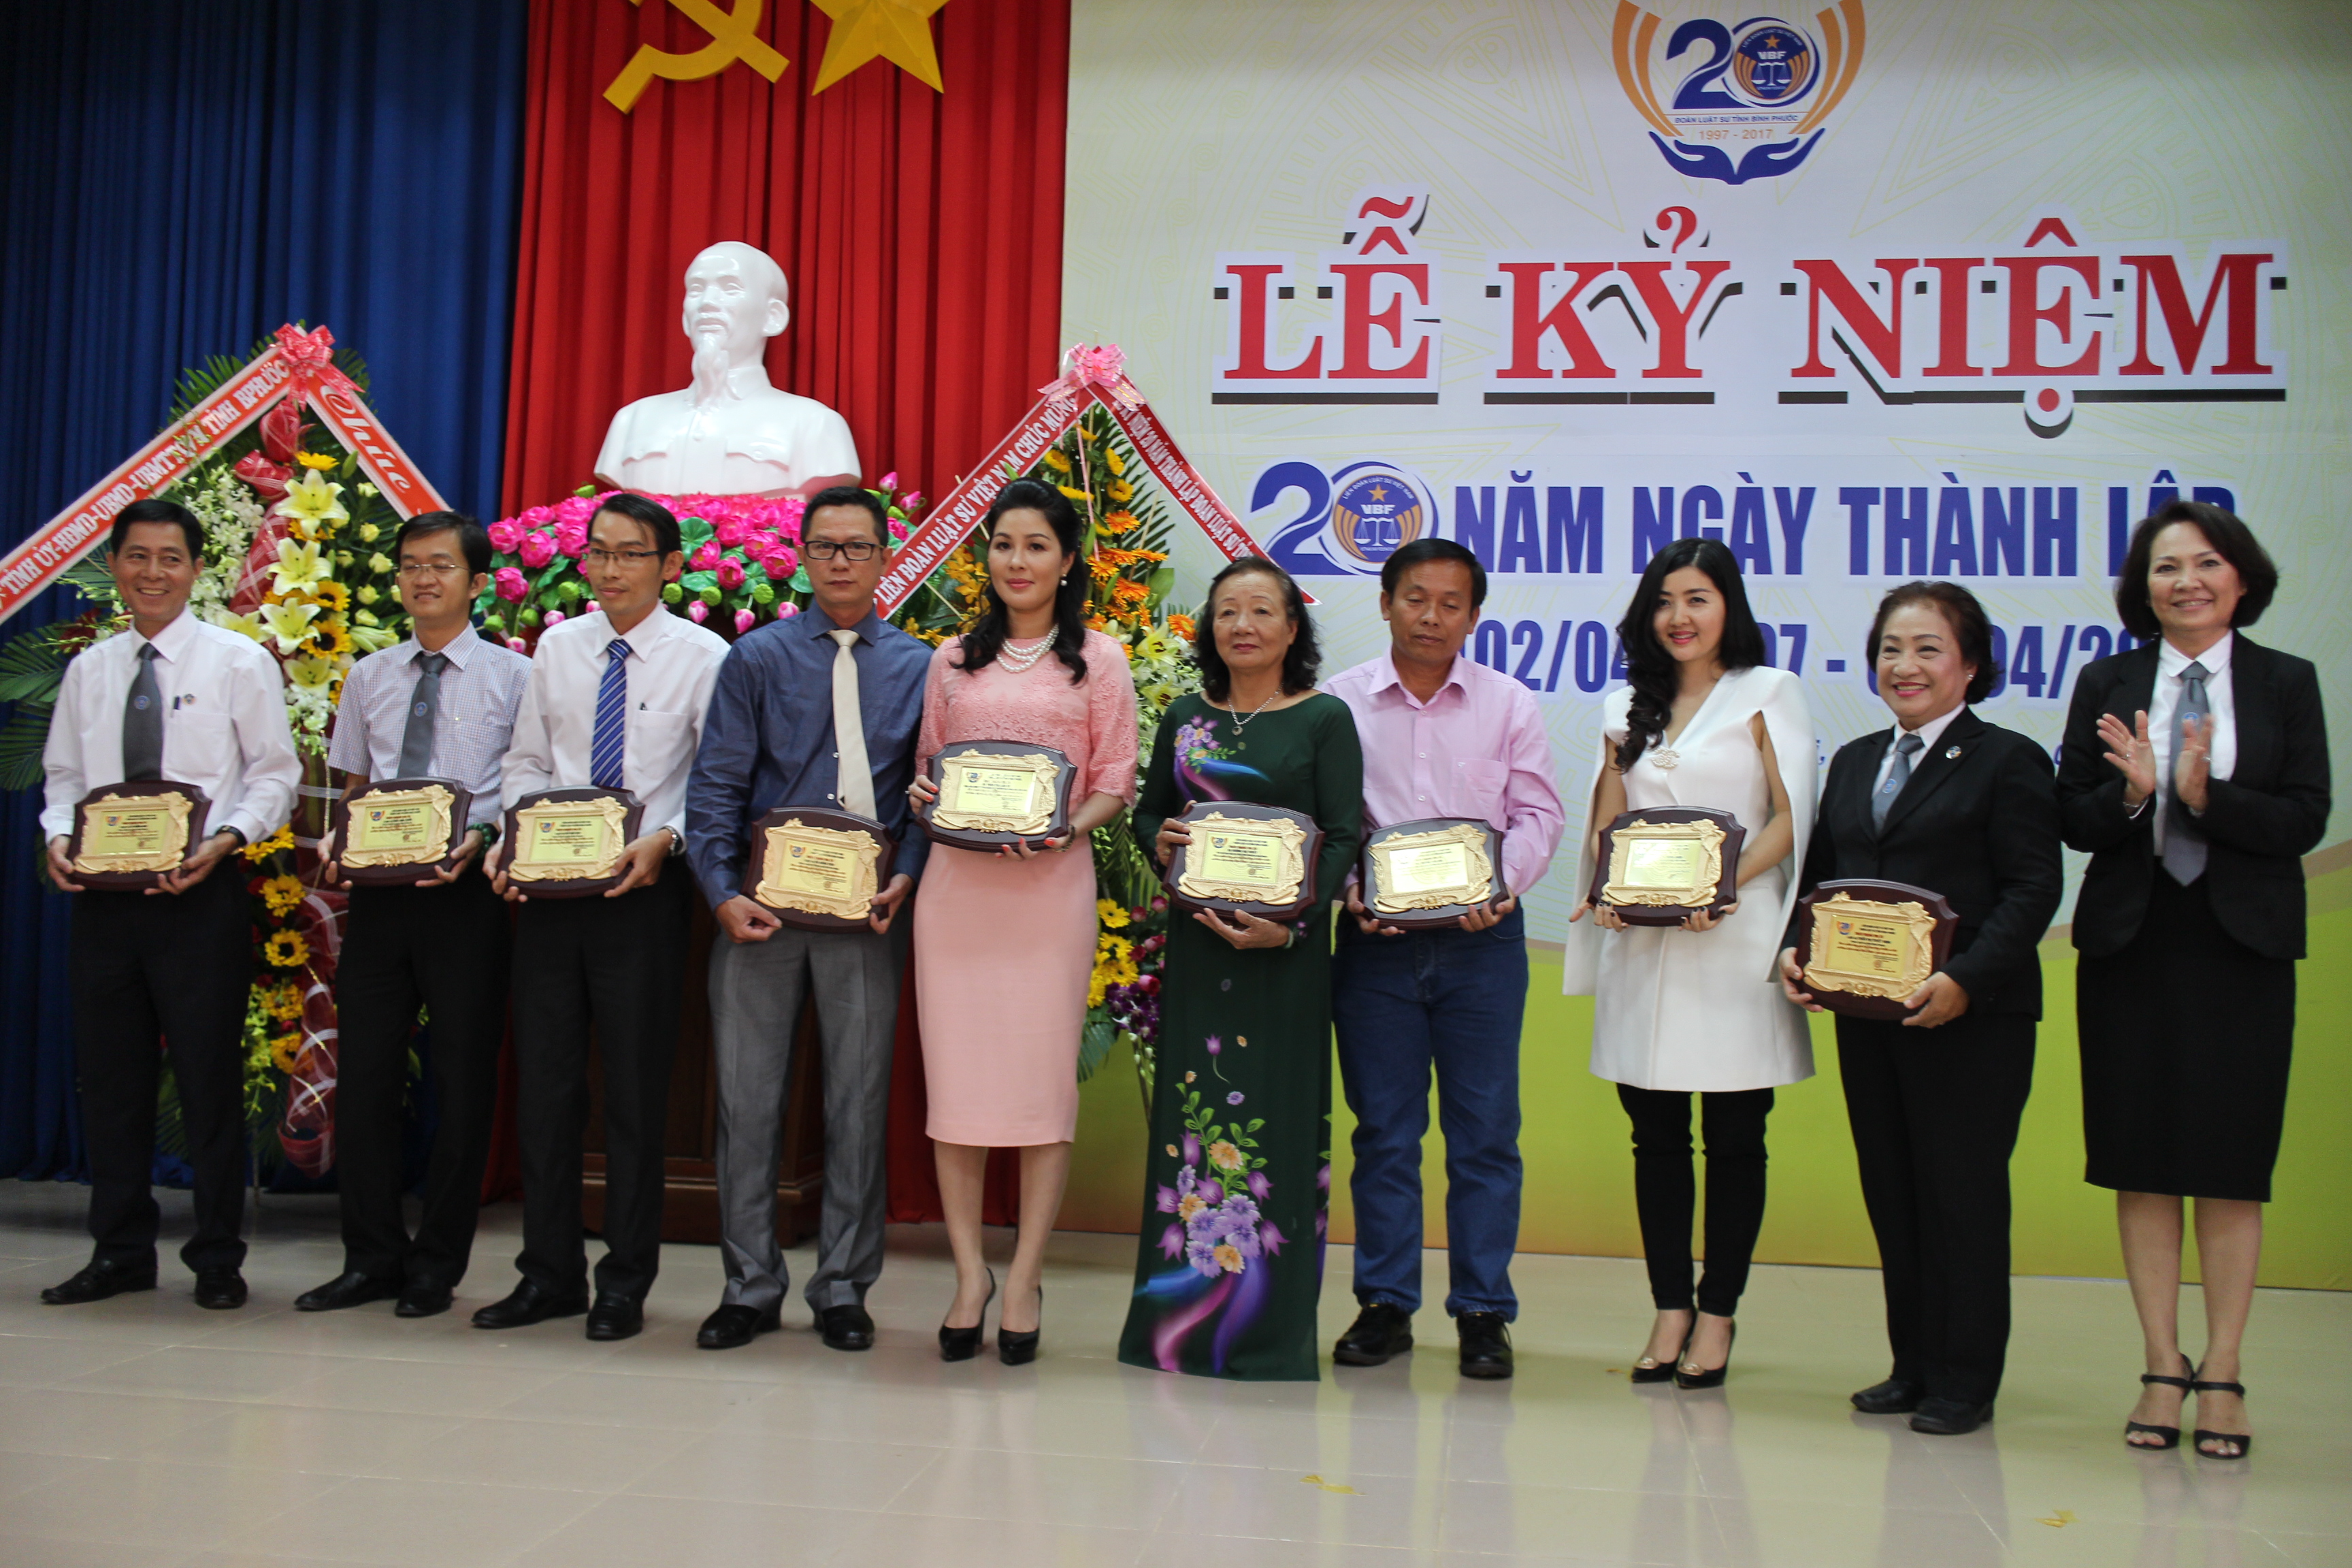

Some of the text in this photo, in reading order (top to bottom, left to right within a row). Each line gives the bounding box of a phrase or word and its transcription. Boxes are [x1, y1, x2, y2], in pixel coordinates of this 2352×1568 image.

[1699, 130, 1729, 140] 1997
[1742, 129, 1774, 140] 2017
[1224, 197, 2273, 412] LỄ KỶ NIỆM
[201, 399, 242, 435] TỈNH
[874, 571, 909, 606] LIÊN
[897, 542, 938, 581] ĐOÀN
[925, 514, 964, 552] LUẬT
[953, 494, 977, 523] SƯ
[966, 474, 1001, 507] VIỆT
[1014, 422, 1051, 459] CHÚC
[1360, 504, 1396, 514] VBF
[1455, 470, 1604, 574] NĂM
[1631, 472, 1816, 575] NGÀY
[1839, 472, 2077, 576] THÀNH
